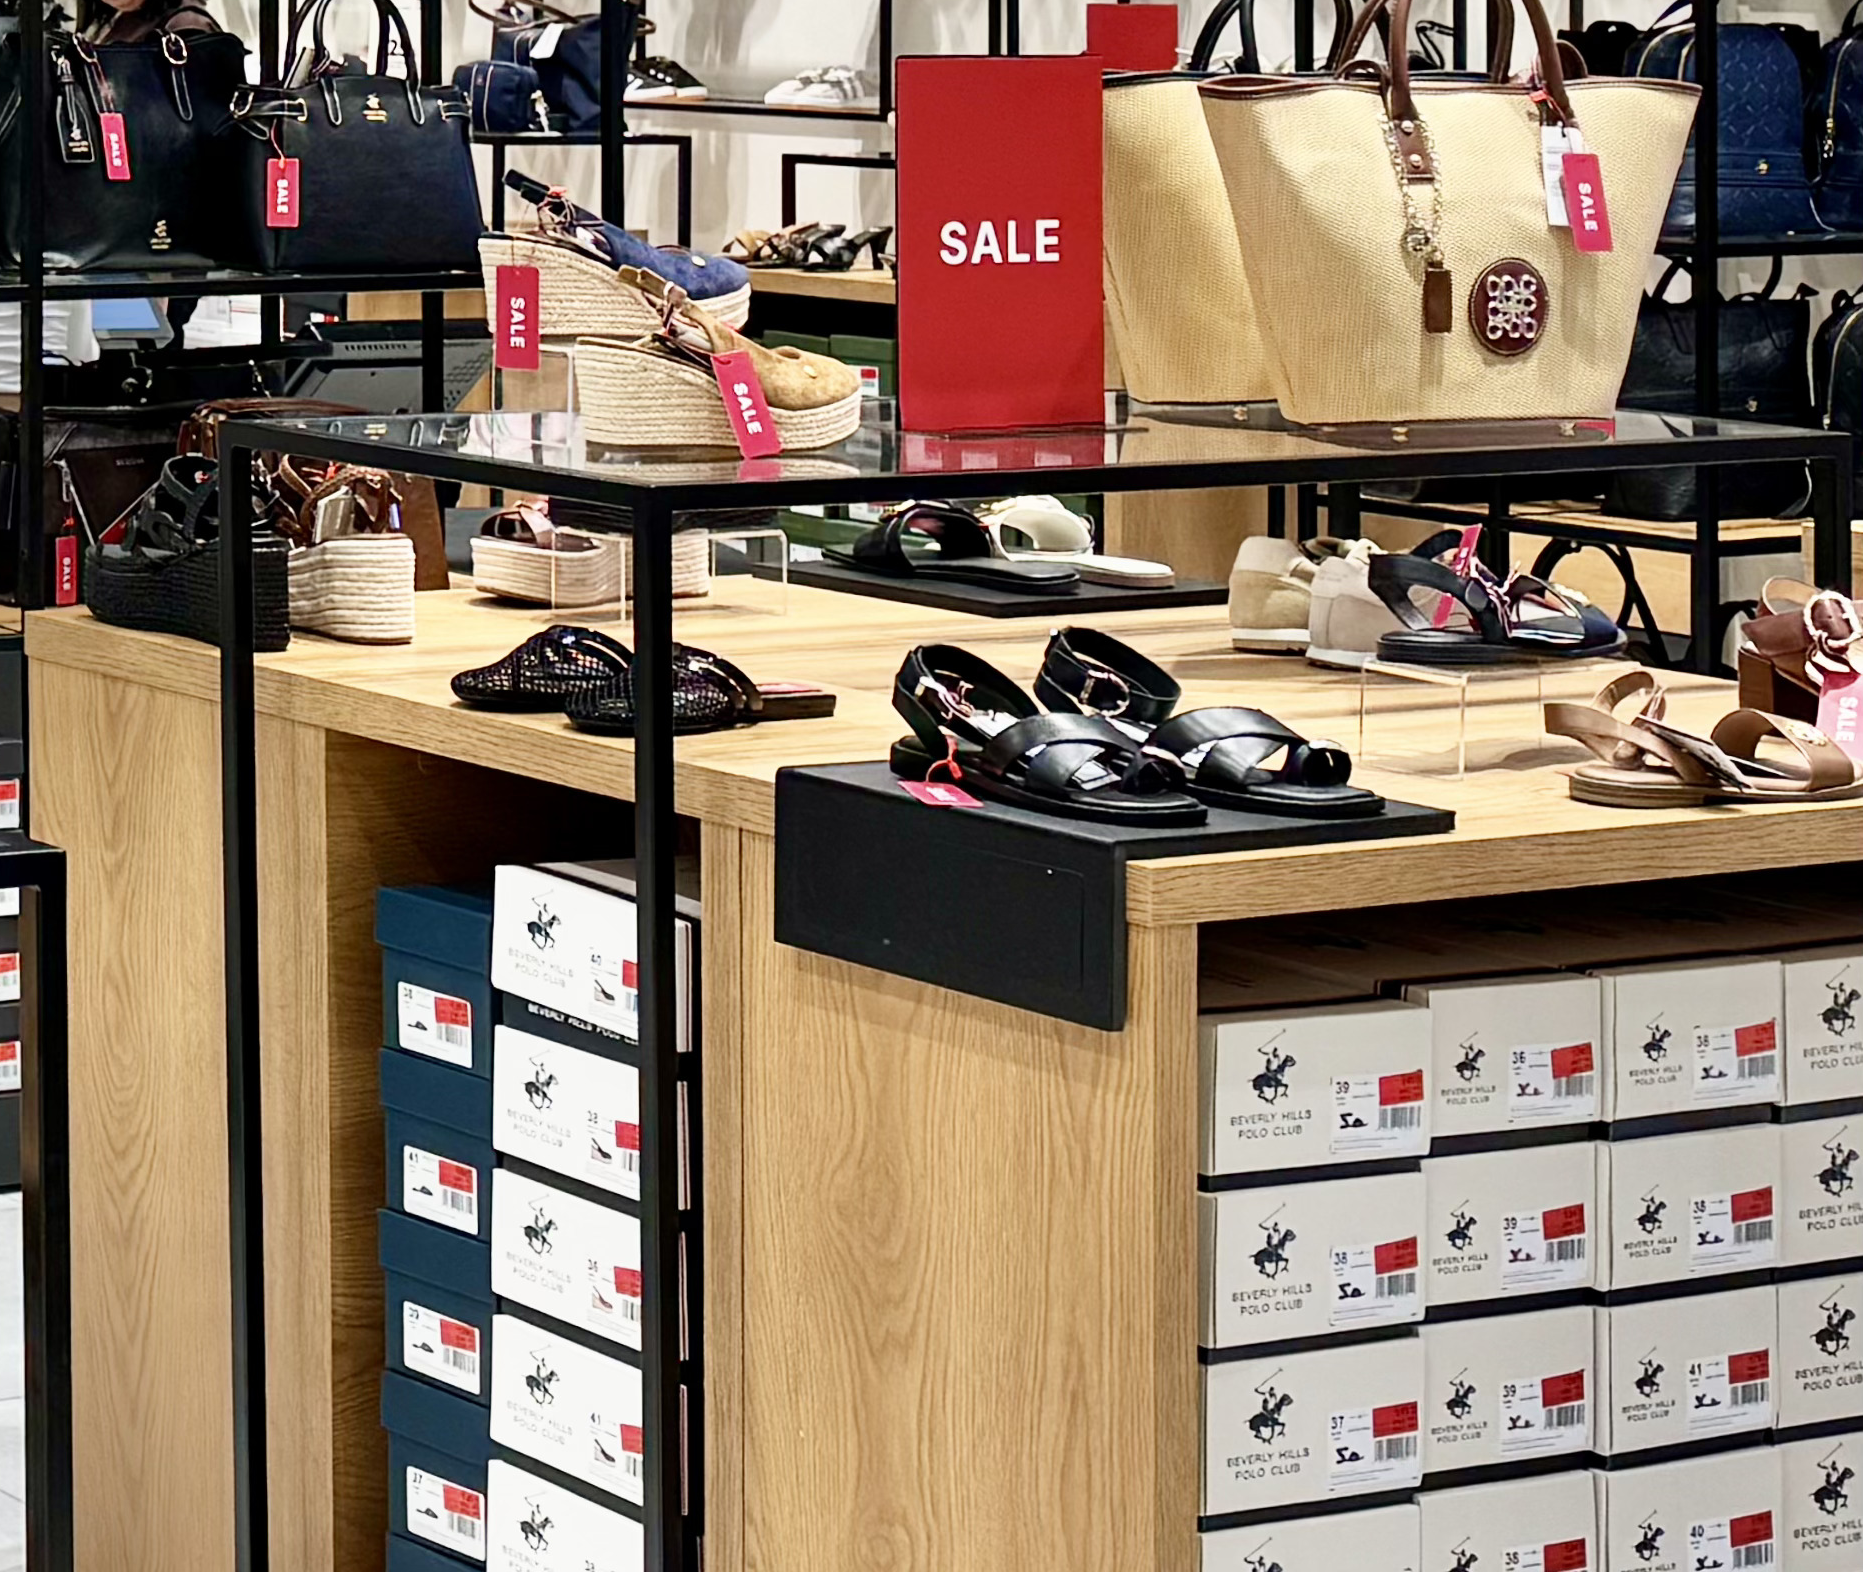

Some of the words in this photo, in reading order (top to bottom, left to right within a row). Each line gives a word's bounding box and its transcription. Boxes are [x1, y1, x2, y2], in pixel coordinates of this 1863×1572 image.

[109, 132, 123, 167] SALE
[276, 179, 290, 214] SALE
[1578, 183, 1599, 231] SALE
[939, 218, 1061, 266] SALE
[510, 297, 526, 349] SALE
[733, 383, 763, 435] SALE
[1834, 696, 1859, 743] SALE
[1803, 1043, 1845, 1058] BEVERLY
[1848, 1042, 1863, 1053] HIL
[1810, 1058, 1838, 1070] POLO
[1842, 1055, 1863, 1066] CLU
[1335, 1081, 1350, 1095] 39
[1230, 1113, 1277, 1126] BEVERLY
[1282, 1109, 1312, 1121] HILLS
[1238, 1128, 1269, 1140] POLO
[1273, 1125, 1303, 1136] CLUB
[1798, 1205, 1843, 1219] BEVERLY
[1847, 1203, 1863, 1214] HIL
[1503, 1217, 1518, 1231] 39
[1807, 1218, 1835, 1231] POLO
[1840, 1215, 1863, 1228] CLU
[1231, 1289, 1278, 1303] BEVERLY
[1282, 1283, 1312, 1296] HILLS
[1240, 1303, 1271, 1316] POLO
[1274, 1299, 1303, 1311] CLUB
[1689, 1363, 1702, 1376] 41
[1794, 1366, 1839, 1380] BEVERLY
[1843, 1362, 1863, 1373] HILL
[1502, 1384, 1517, 1398] 39
[1803, 1379, 1831, 1391] POLO
[1331, 1416, 1345, 1430] 37
[1226, 1452, 1274, 1468] BEVERLY
[1278, 1447, 1310, 1460] HILLS
[1234, 1467, 1265, 1480] POLO
[1271, 1463, 1301, 1475] CLUB
[1690, 1526, 1705, 1538] 40
[1793, 1524, 1839, 1539] BEVERLY
[1842, 1519, 1863, 1532] HILL
[1801, 1538, 1830, 1551] POLO
